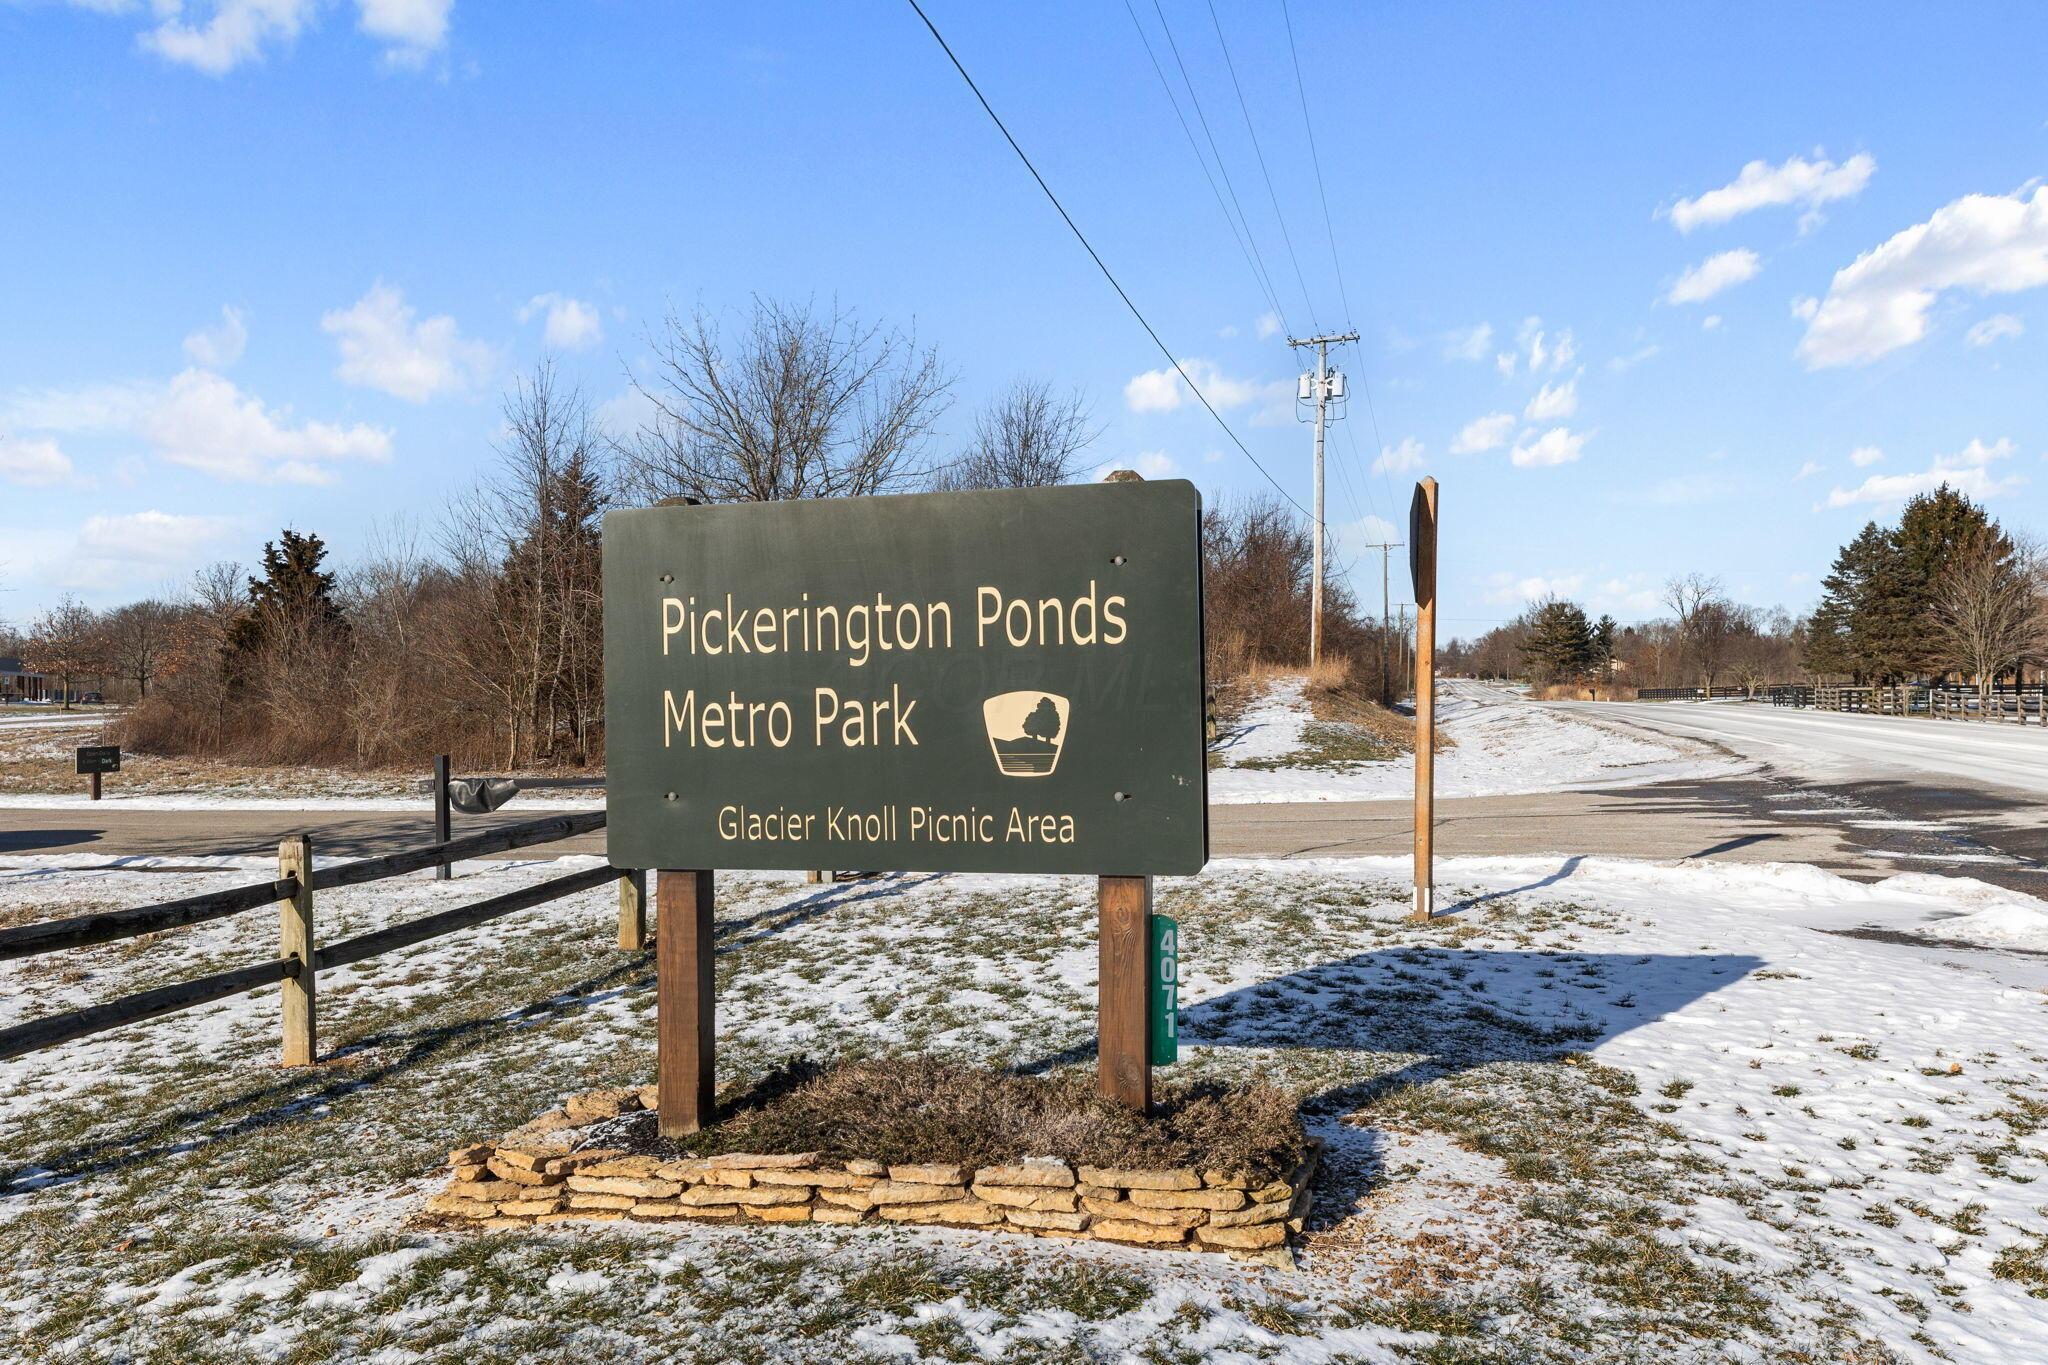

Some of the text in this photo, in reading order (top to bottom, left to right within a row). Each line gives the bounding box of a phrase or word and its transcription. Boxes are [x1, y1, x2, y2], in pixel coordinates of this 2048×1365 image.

[662, 579, 1128, 667] Pickerington Ponds
[664, 683, 919, 749] Metro Park
[718, 805, 1075, 844] Glacier Knoll Picnic Area
[1160, 929, 1176, 1038] 4071
